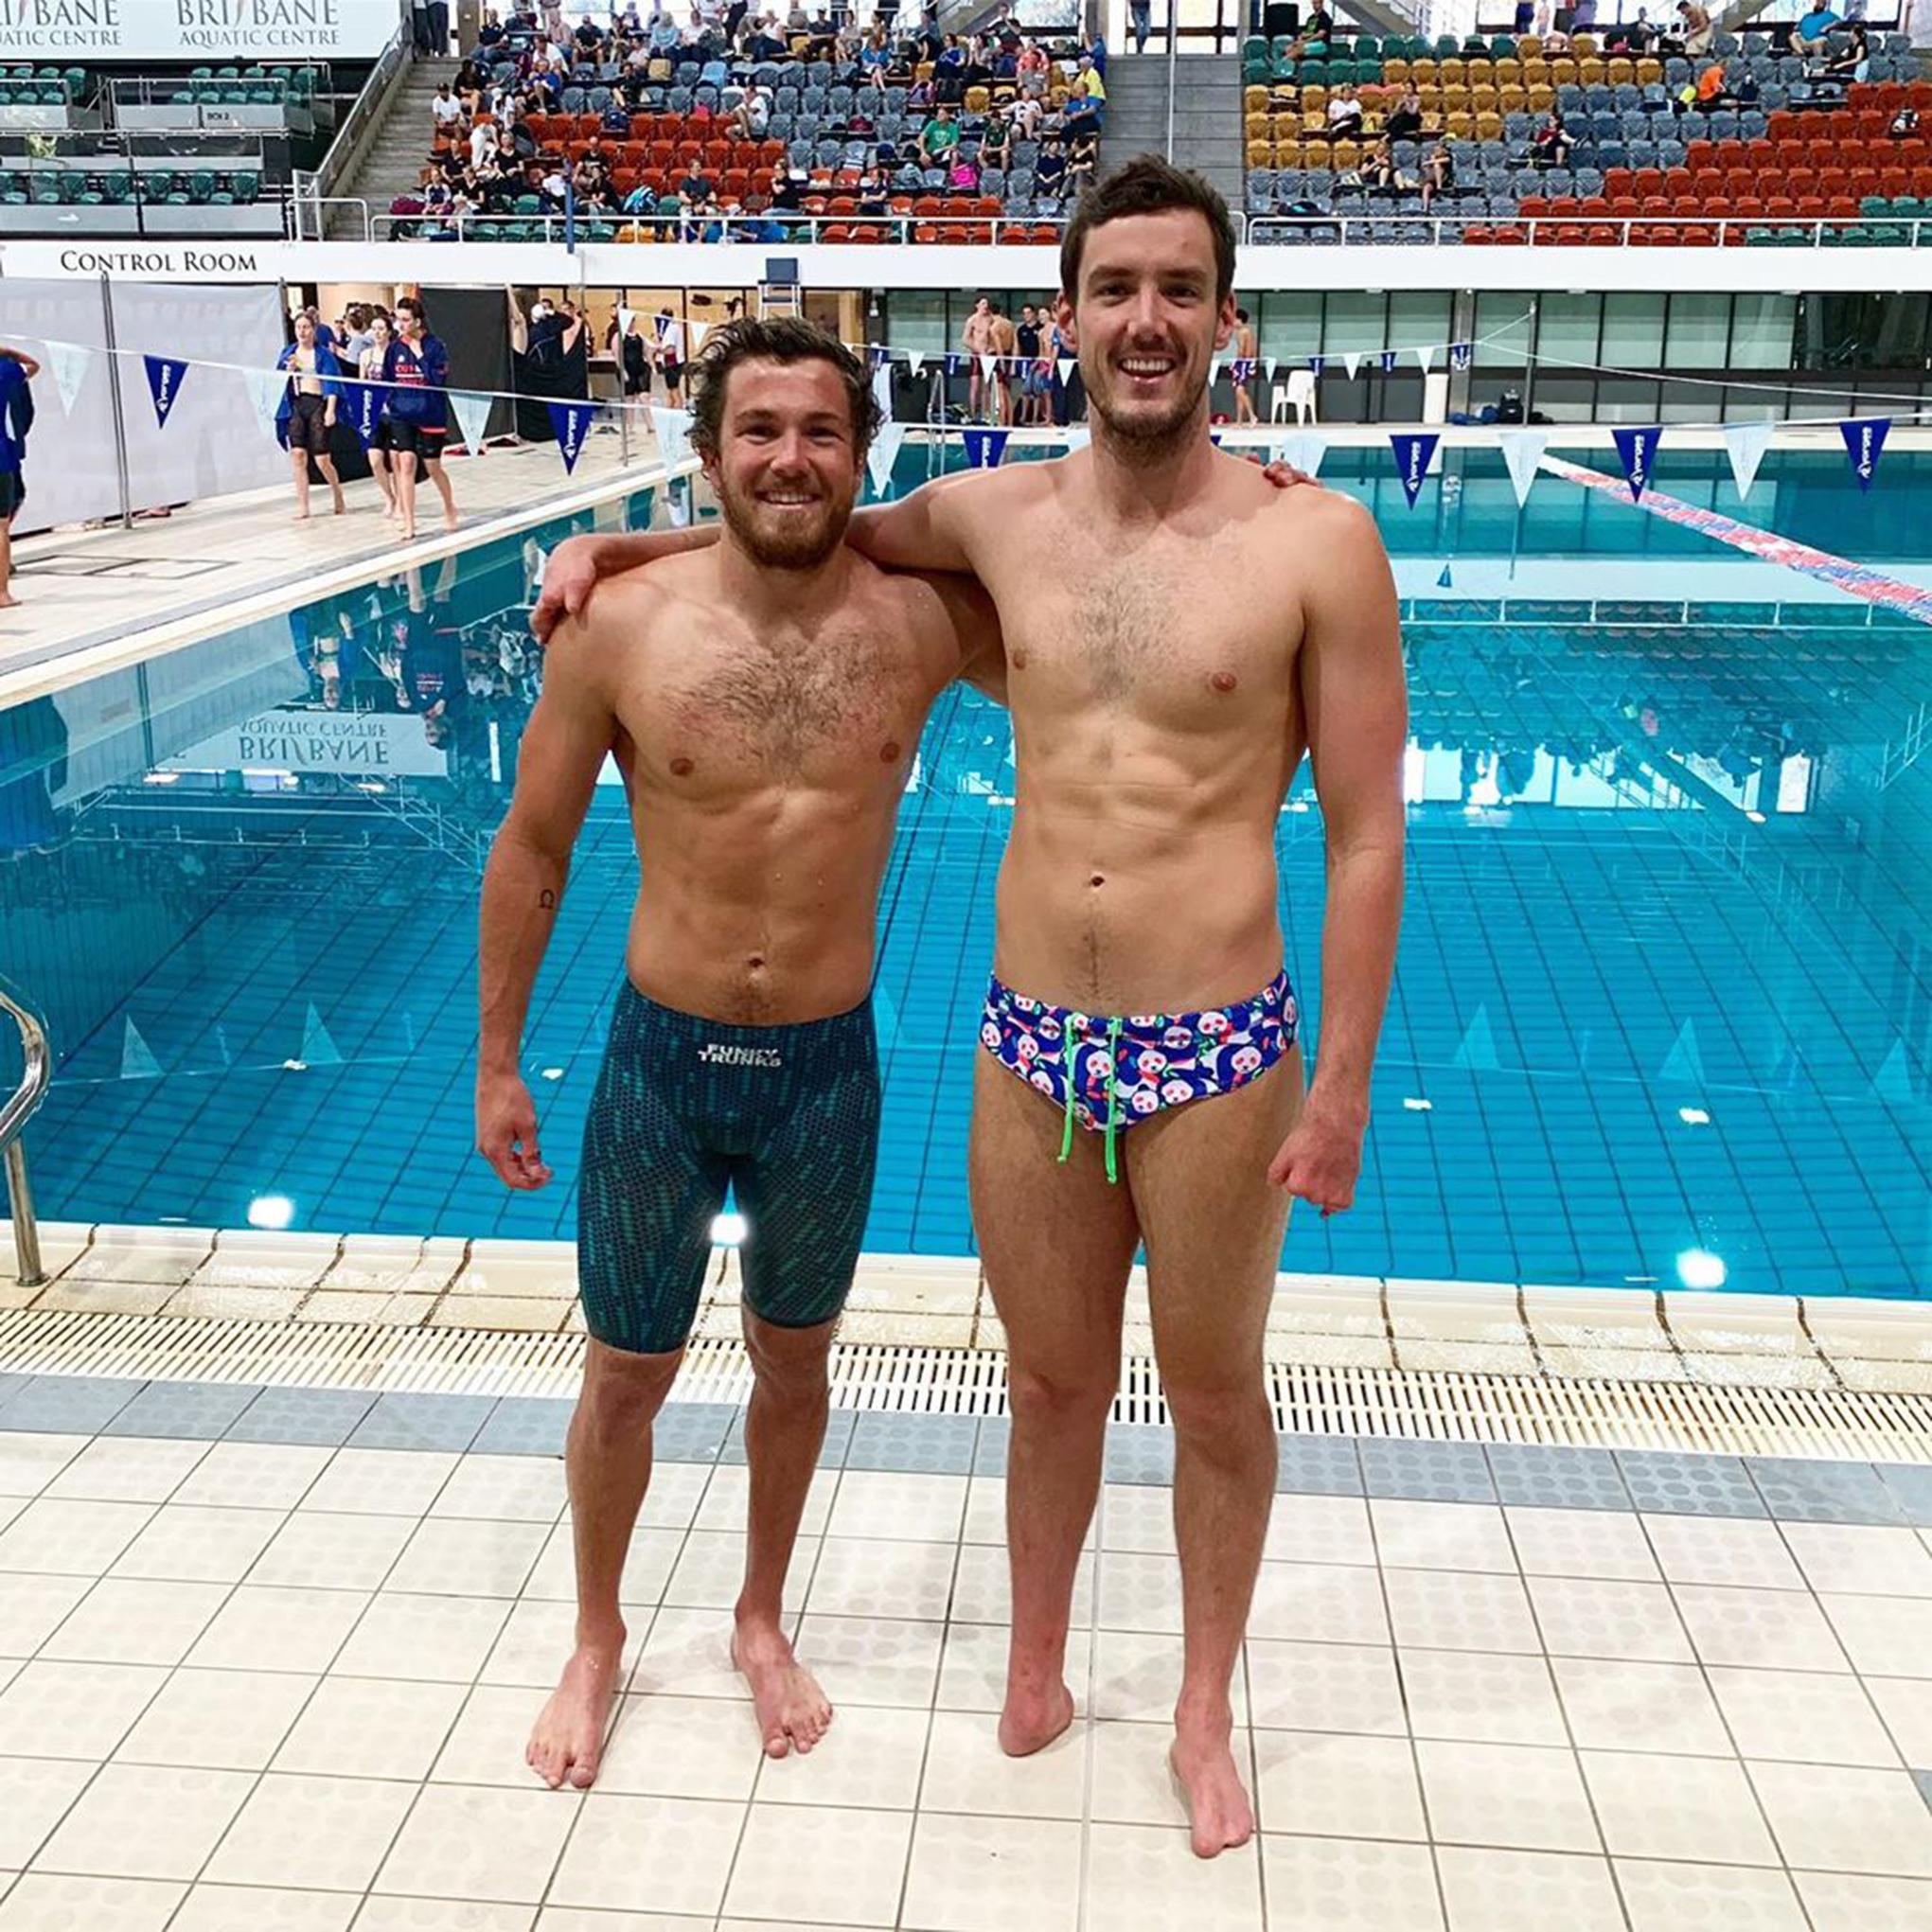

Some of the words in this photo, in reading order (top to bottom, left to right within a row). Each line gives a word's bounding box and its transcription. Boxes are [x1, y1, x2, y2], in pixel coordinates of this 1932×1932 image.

[0, 29, 45, 45] ATIC
[49, 29, 122, 46] CENTRE
[179, 29, 263, 49] AQUATIC
[267, 29, 341, 46] CENTRE
[60, 250, 176, 272] CONTROL
[184, 251, 257, 272] ROOM
[698, 1049, 782, 1068] TRUNKS
[706, 1043, 778, 1061] FUNKY
